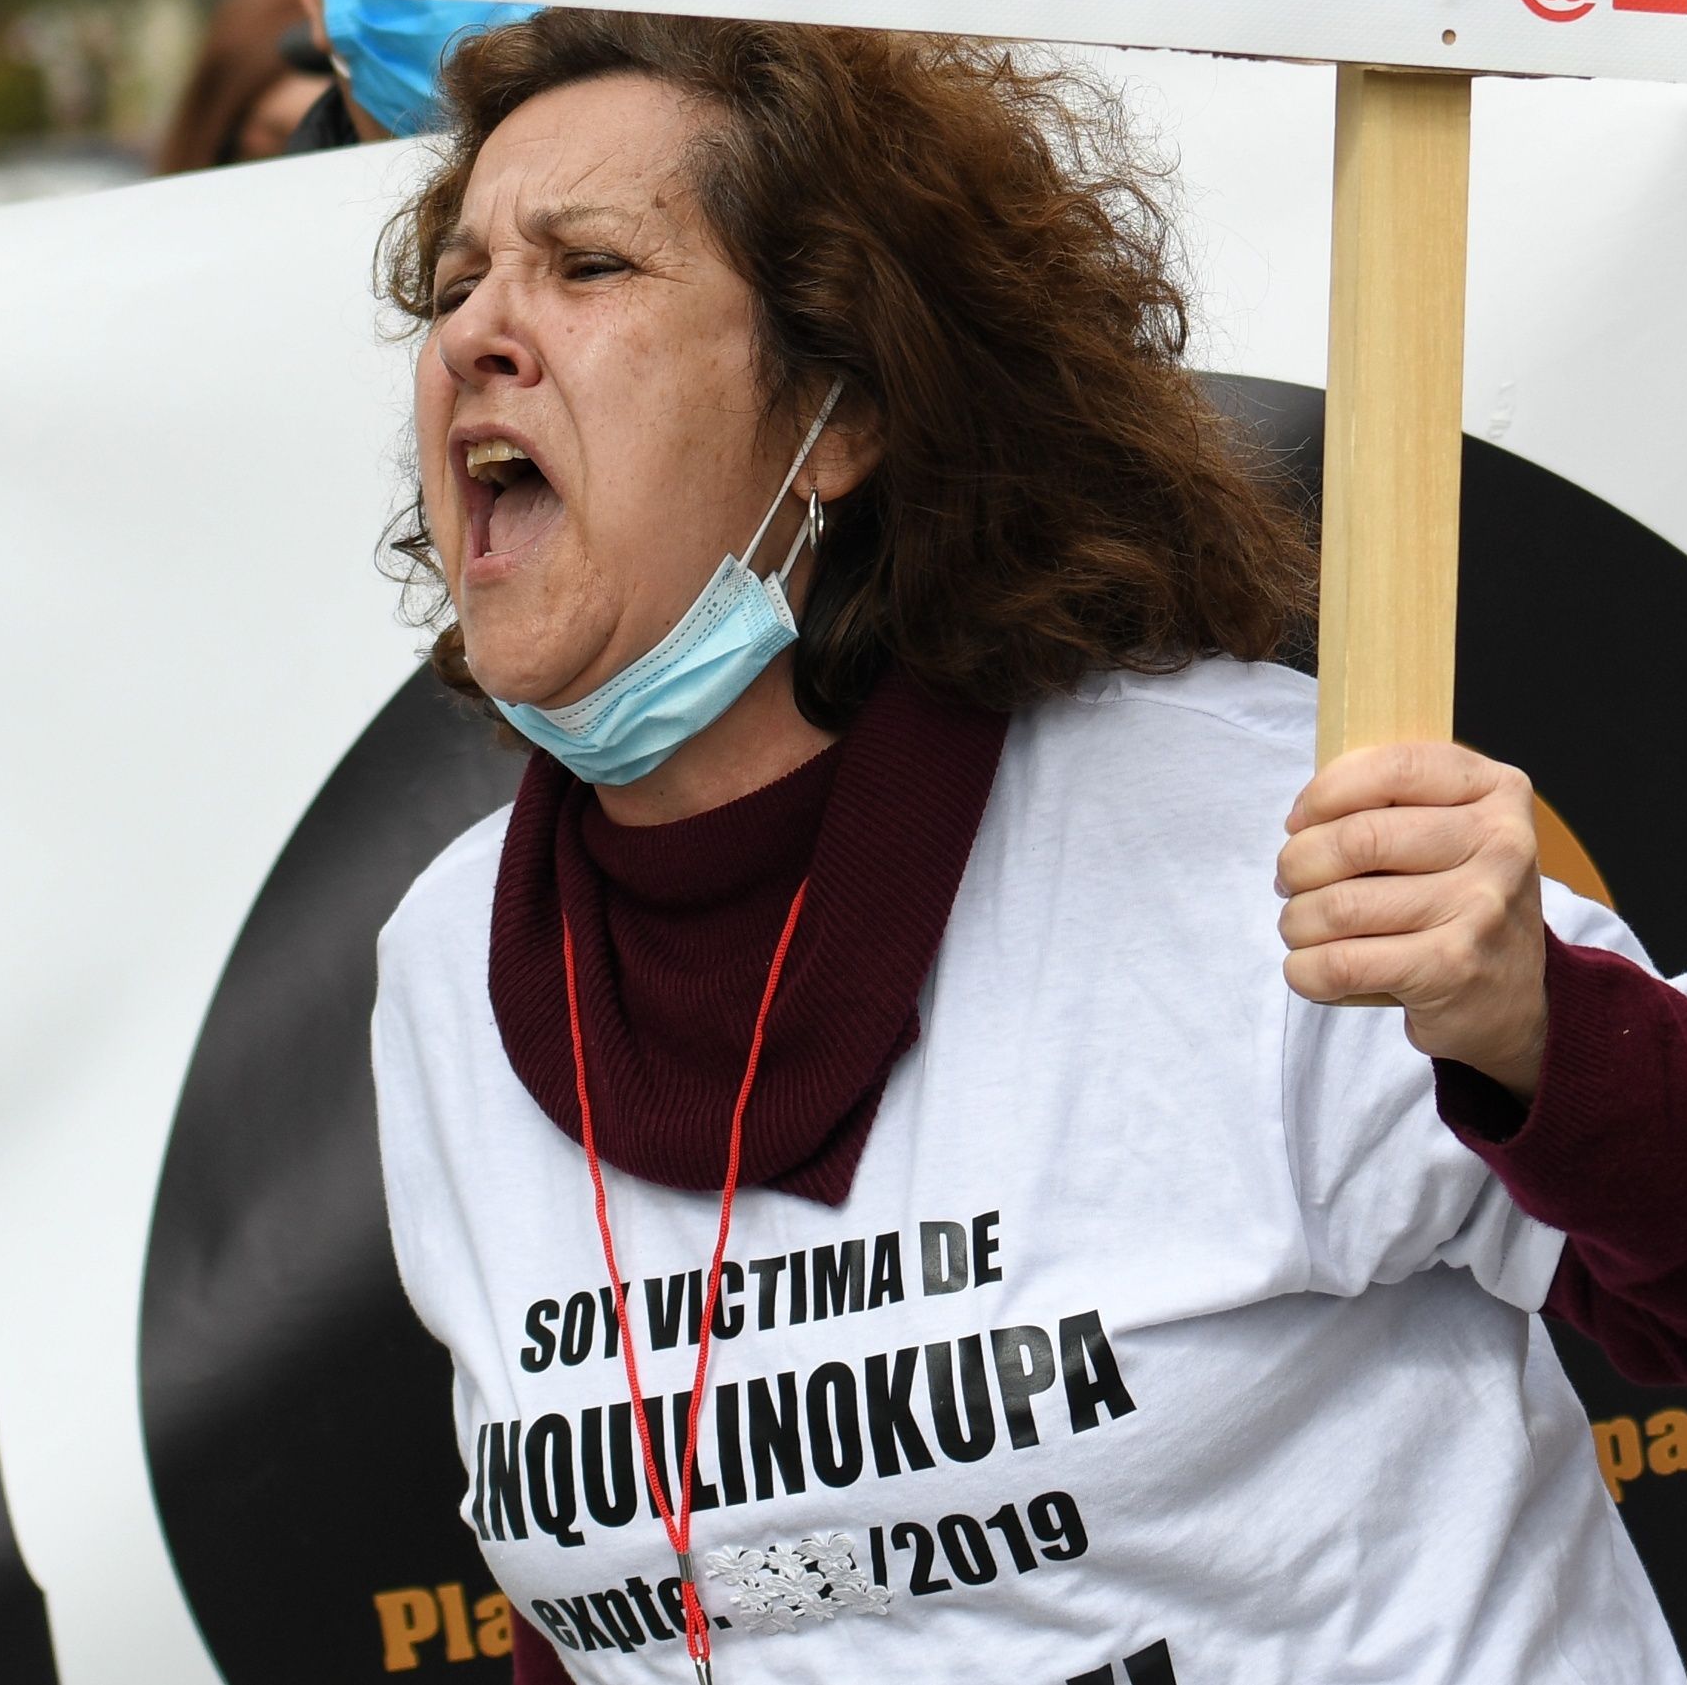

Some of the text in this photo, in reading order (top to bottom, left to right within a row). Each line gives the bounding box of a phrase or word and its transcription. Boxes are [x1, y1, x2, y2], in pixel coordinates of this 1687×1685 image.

[521, 1210, 1003, 1373] SOY VICTIMA DE
[471, 1309, 1137, 1548] INQUILINOKUPA
